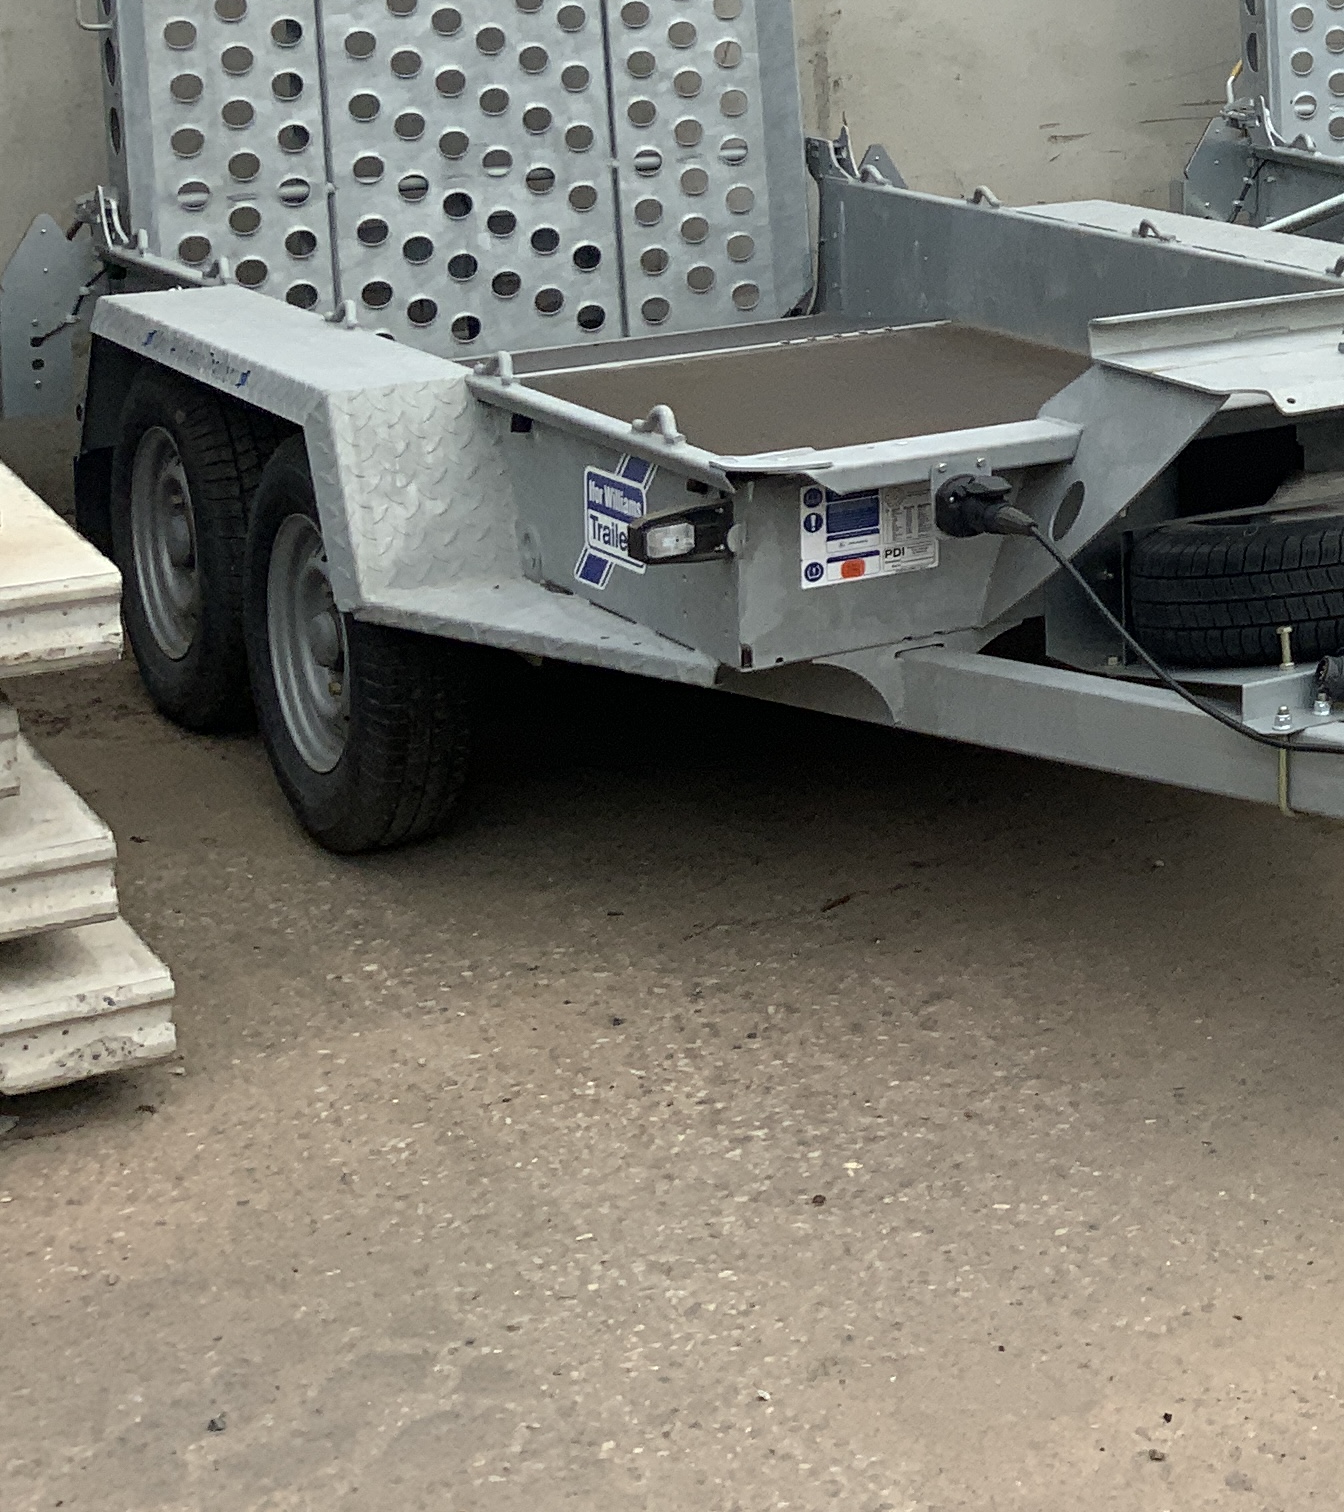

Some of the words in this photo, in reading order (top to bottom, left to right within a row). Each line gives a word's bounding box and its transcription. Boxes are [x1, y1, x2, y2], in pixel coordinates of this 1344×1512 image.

[603, 484, 643, 518] Williams
[589, 513, 628, 552] Traile
[884, 546, 905, 558] PDI
